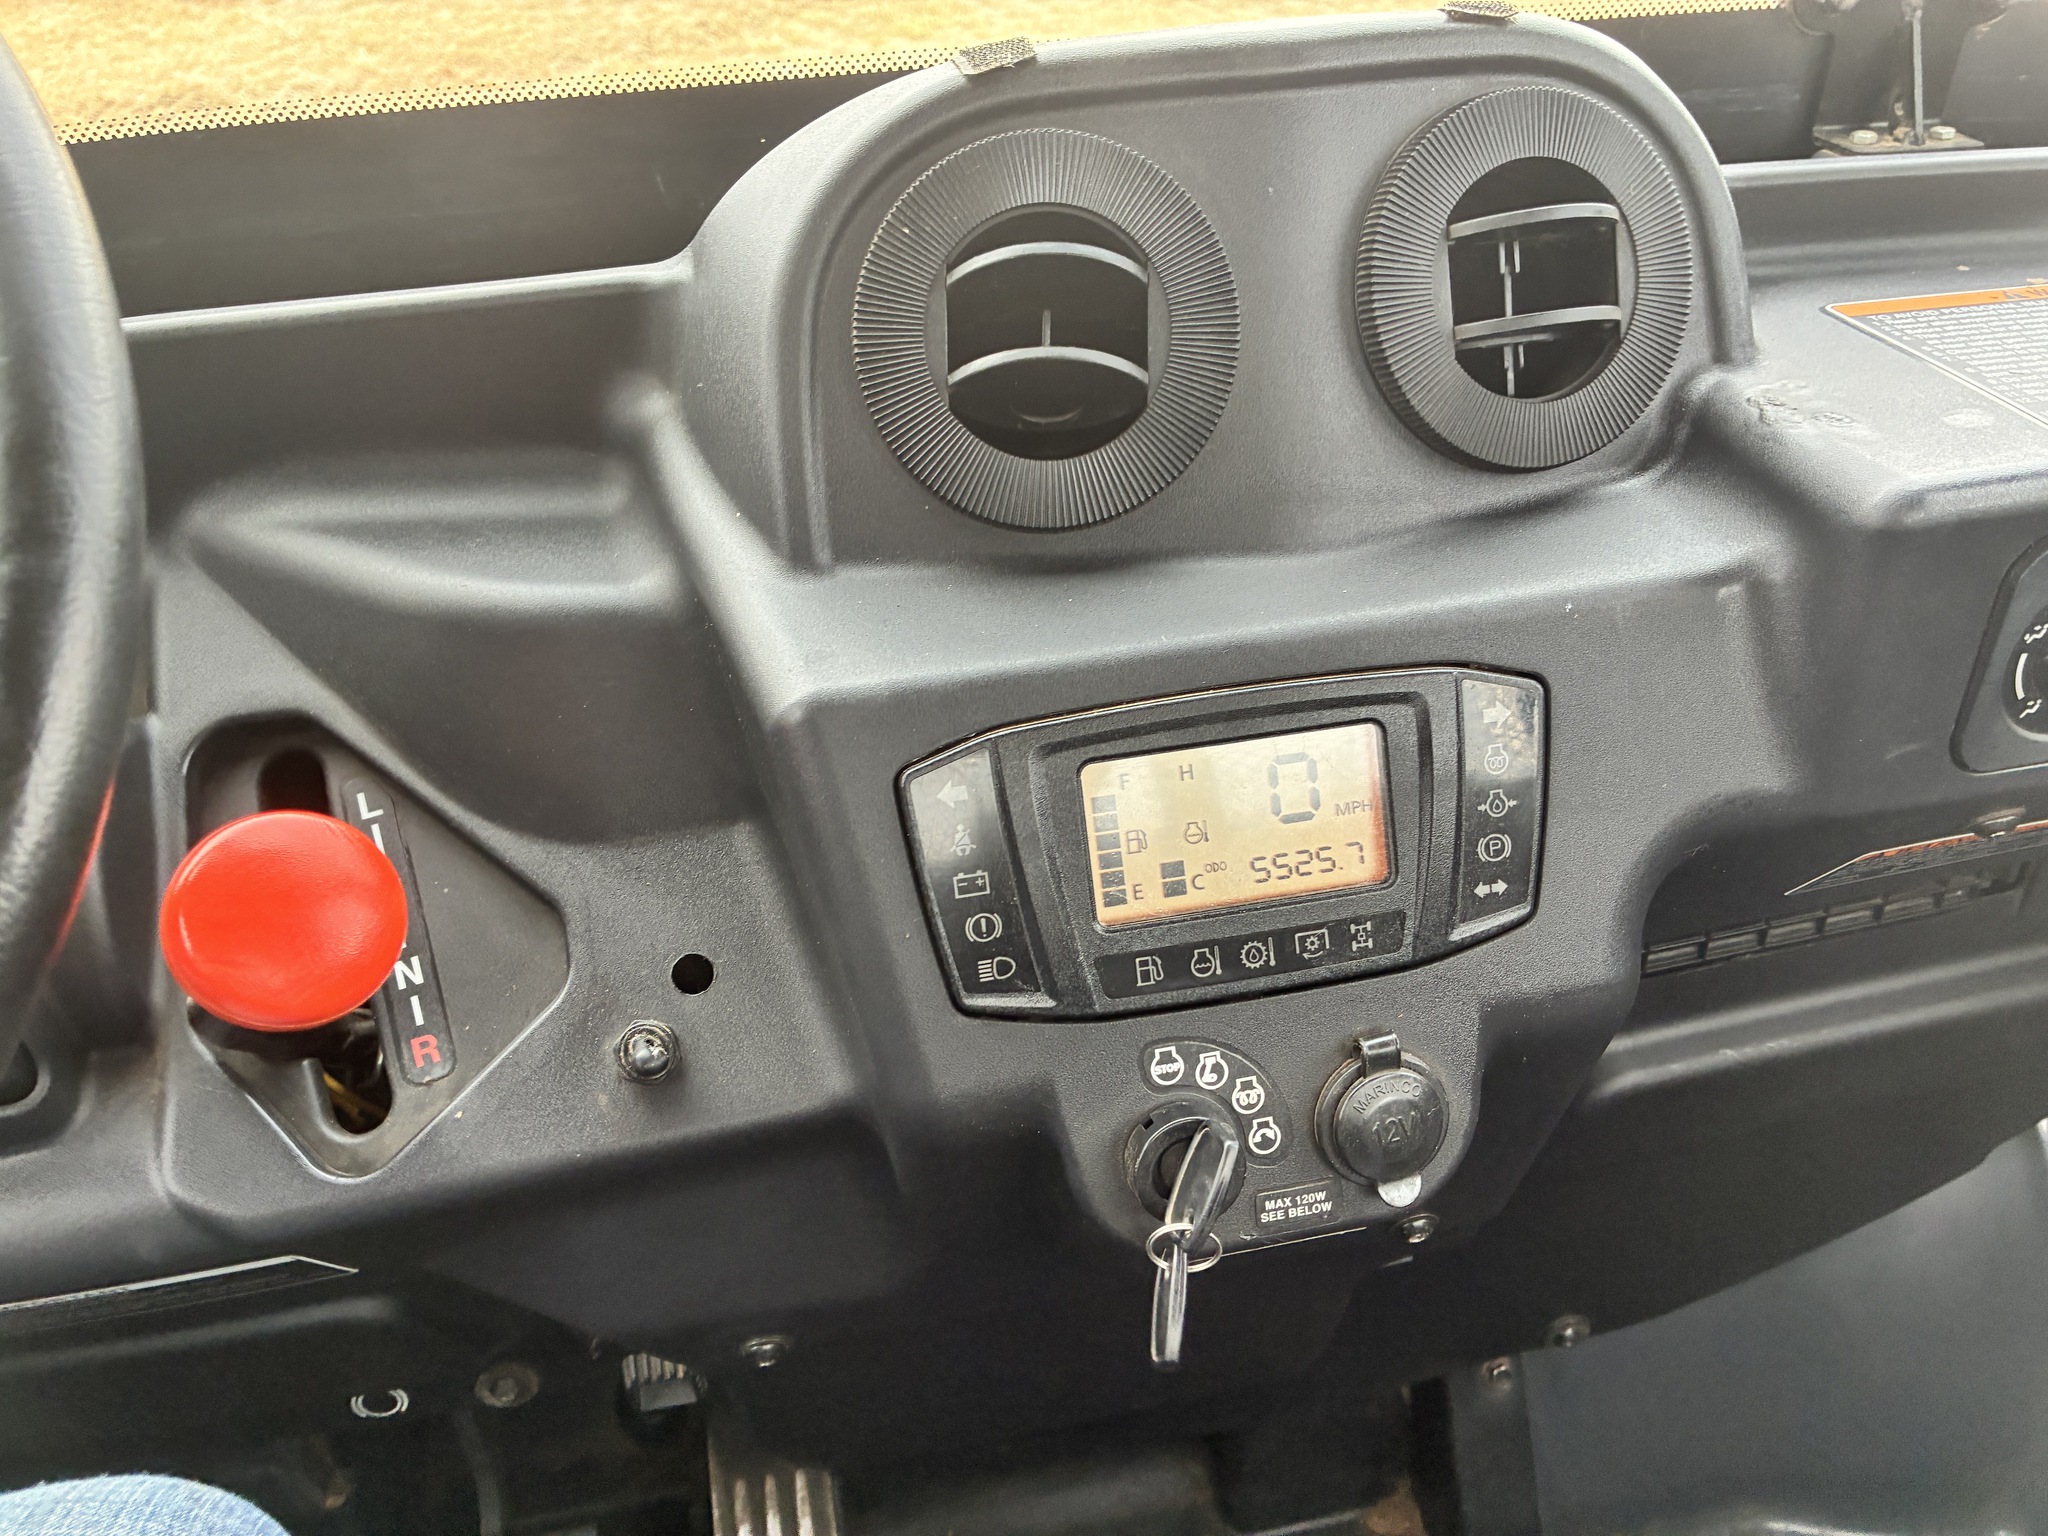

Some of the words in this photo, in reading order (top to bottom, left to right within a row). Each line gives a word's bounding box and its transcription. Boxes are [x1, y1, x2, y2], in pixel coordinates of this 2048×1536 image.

[1867, 314, 1891, 322] TO
[1894, 309, 1940, 319] AVOID
[1940, 302, 2021, 314] PERSONAL
[1118, 773, 1130, 790] F
[1179, 764, 1194, 782] H
[1267, 752, 1321, 825] 0
[356, 792, 384, 821] L
[1334, 800, 1374, 817] MPH
[1205, 861, 1228, 873] ODO
[1250, 841, 1366, 883] 5525.7
[1133, 884, 1144, 900] E
[1192, 874, 1205, 890] C
[393, 955, 425, 991] N
[410, 1033, 441, 1068] R
[1154, 1061, 1181, 1076] STOP
[1353, 1080, 1421, 1114] MARINCO
[1372, 1112, 1416, 1145] 12V
[1264, 1197, 1292, 1210] MAX
[1295, 1190, 1327, 1206] 120W
[1260, 1210, 1285, 1222] SEE
[1288, 1201, 1332, 1218] BELOW
